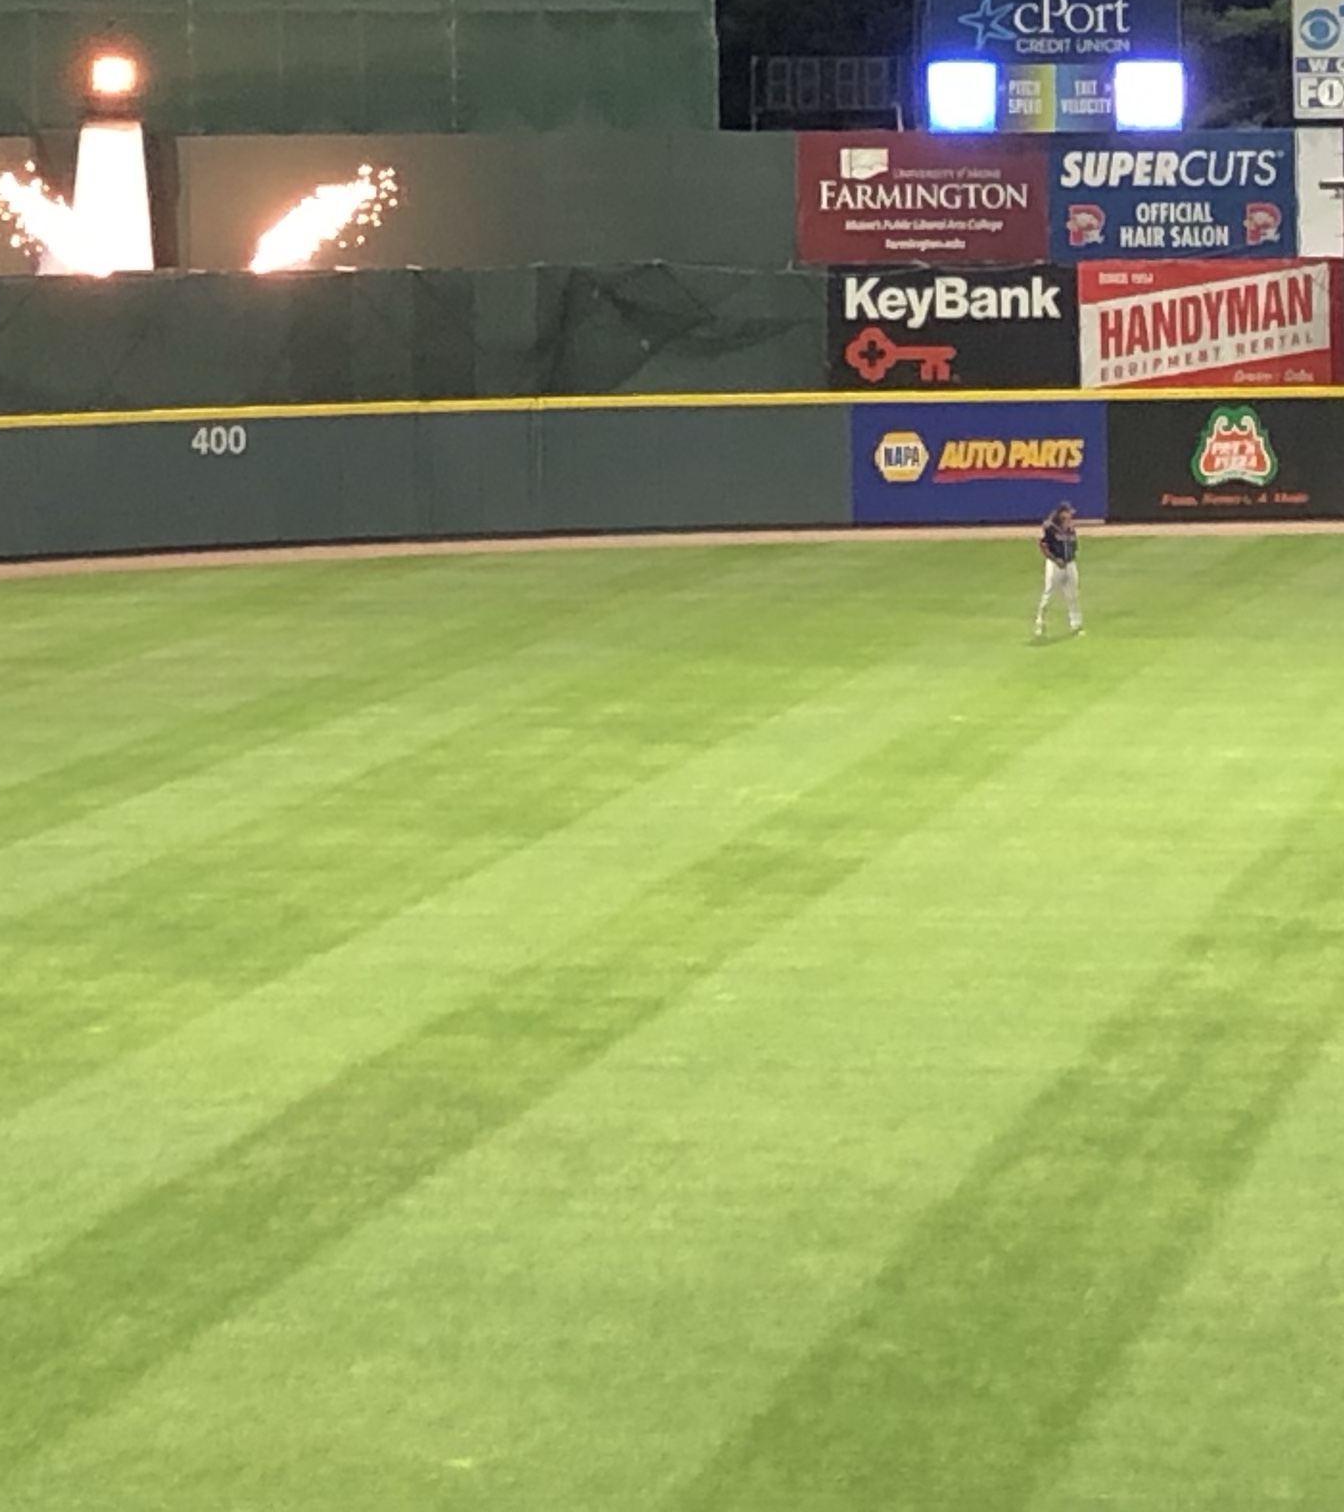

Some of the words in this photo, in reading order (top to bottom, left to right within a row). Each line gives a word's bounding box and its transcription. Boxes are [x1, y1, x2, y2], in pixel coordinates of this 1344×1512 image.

[1016, 38, 1072, 54] CREDIT
[1076, 38, 1131, 54] UNION
[1060, 150, 1279, 187] SUPERCUTS
[818, 179, 1029, 211] FARMINGTON
[1136, 202, 1214, 225] OFFICIAL
[1119, 224, 1164, 248] HAIR
[1169, 224, 1230, 248] SALON
[845, 277, 1061, 329] KeyBank
[1100, 273, 1314, 361] HANDYMAN
[1100, 346, 1221, 383] EQUIPMENT
[1235, 332, 1314, 358] RENTAL
[191, 425, 247, 455] 400
[938, 440, 1009, 471] AUTO
[1008, 437, 1085, 470] PARTS
[882, 445, 921, 470] NAPA
